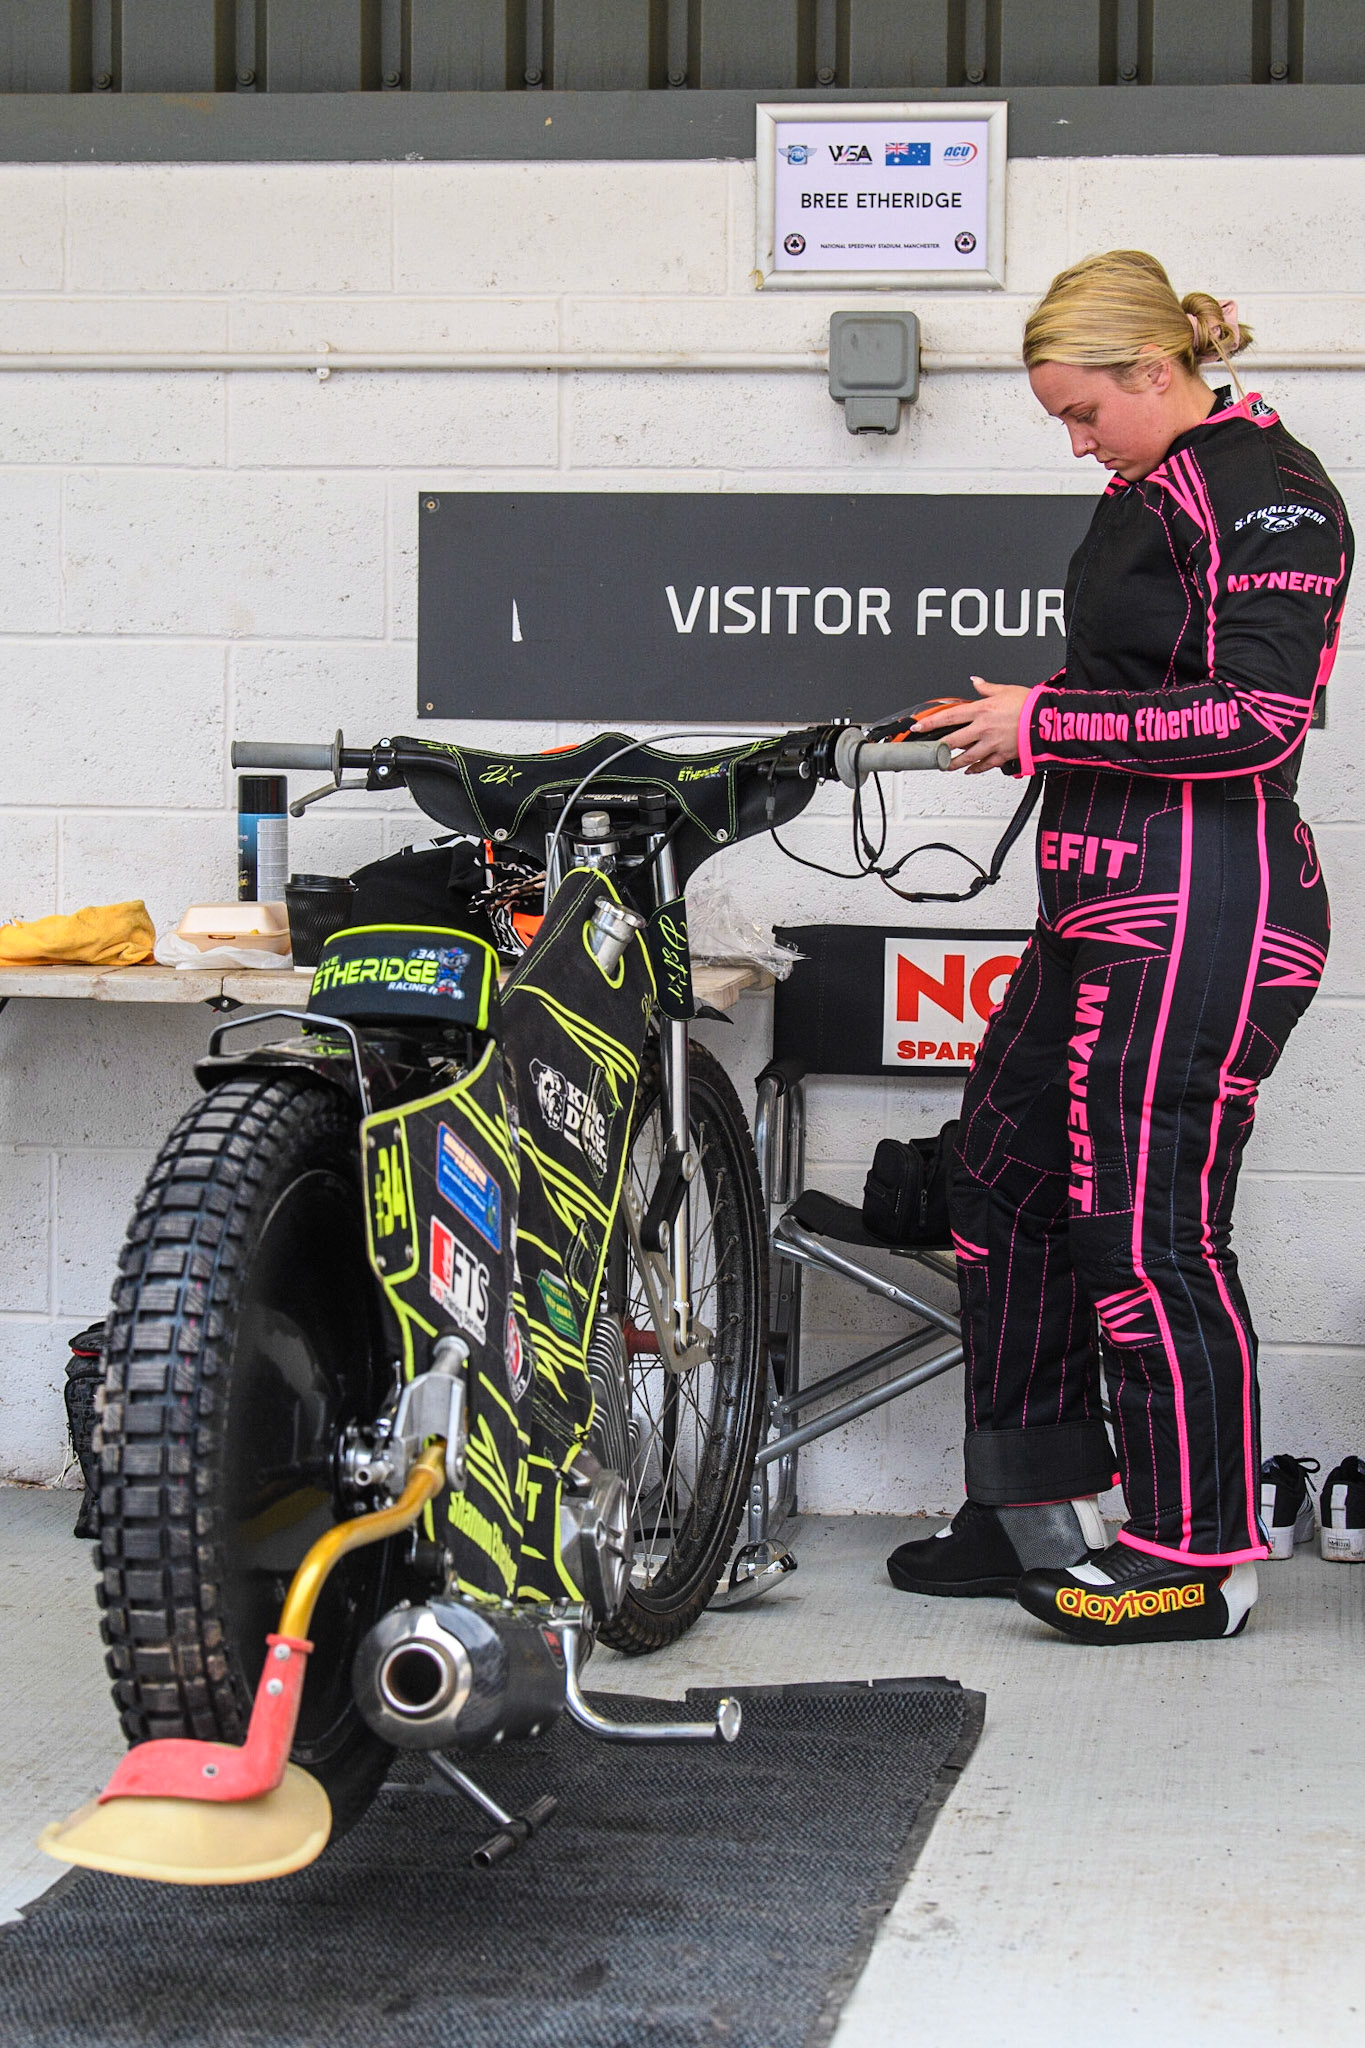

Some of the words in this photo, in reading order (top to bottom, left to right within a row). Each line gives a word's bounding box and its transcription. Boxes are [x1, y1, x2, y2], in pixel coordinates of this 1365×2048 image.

[943, 146, 970, 157] ACU
[801, 194, 848, 208] BREE
[857, 193, 962, 208] ETHERIDGE
[1227, 572, 1336, 597] MYNEFIT
[665, 586, 891, 635] VISITOR
[917, 588, 1066, 637] FOUR
[1038, 707, 1128, 743] Shannon
[1135, 698, 1240, 741] Etheridge
[1041, 830, 1138, 879] EFIT
[311, 957, 440, 997] ETHERIDGE
[388, 981, 426, 992] RACING
[897, 1040, 982, 1060] SPAR
[1068, 983, 1110, 1213] MYNEFIT
[452, 1242, 487, 1323] FTS
[1055, 1583, 1205, 1625] daytona
